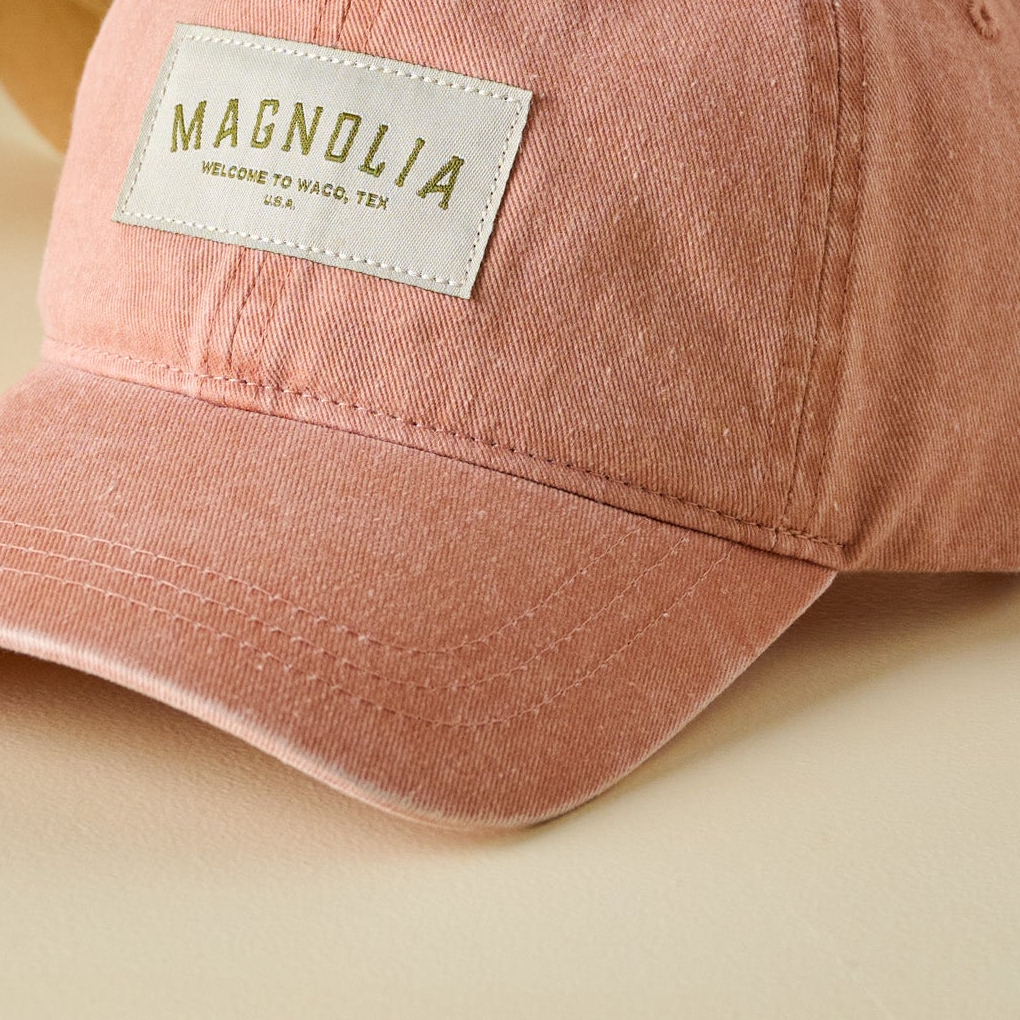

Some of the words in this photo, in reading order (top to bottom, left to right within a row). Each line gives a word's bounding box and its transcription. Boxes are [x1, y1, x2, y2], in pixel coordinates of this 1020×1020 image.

[170, 97, 466, 210] MAGNOLIA
[201, 160, 269, 185] WELCOME
[272, 172, 293, 190] TO
[297, 177, 349, 205] WACO,
[356, 190, 390, 211] TEX
